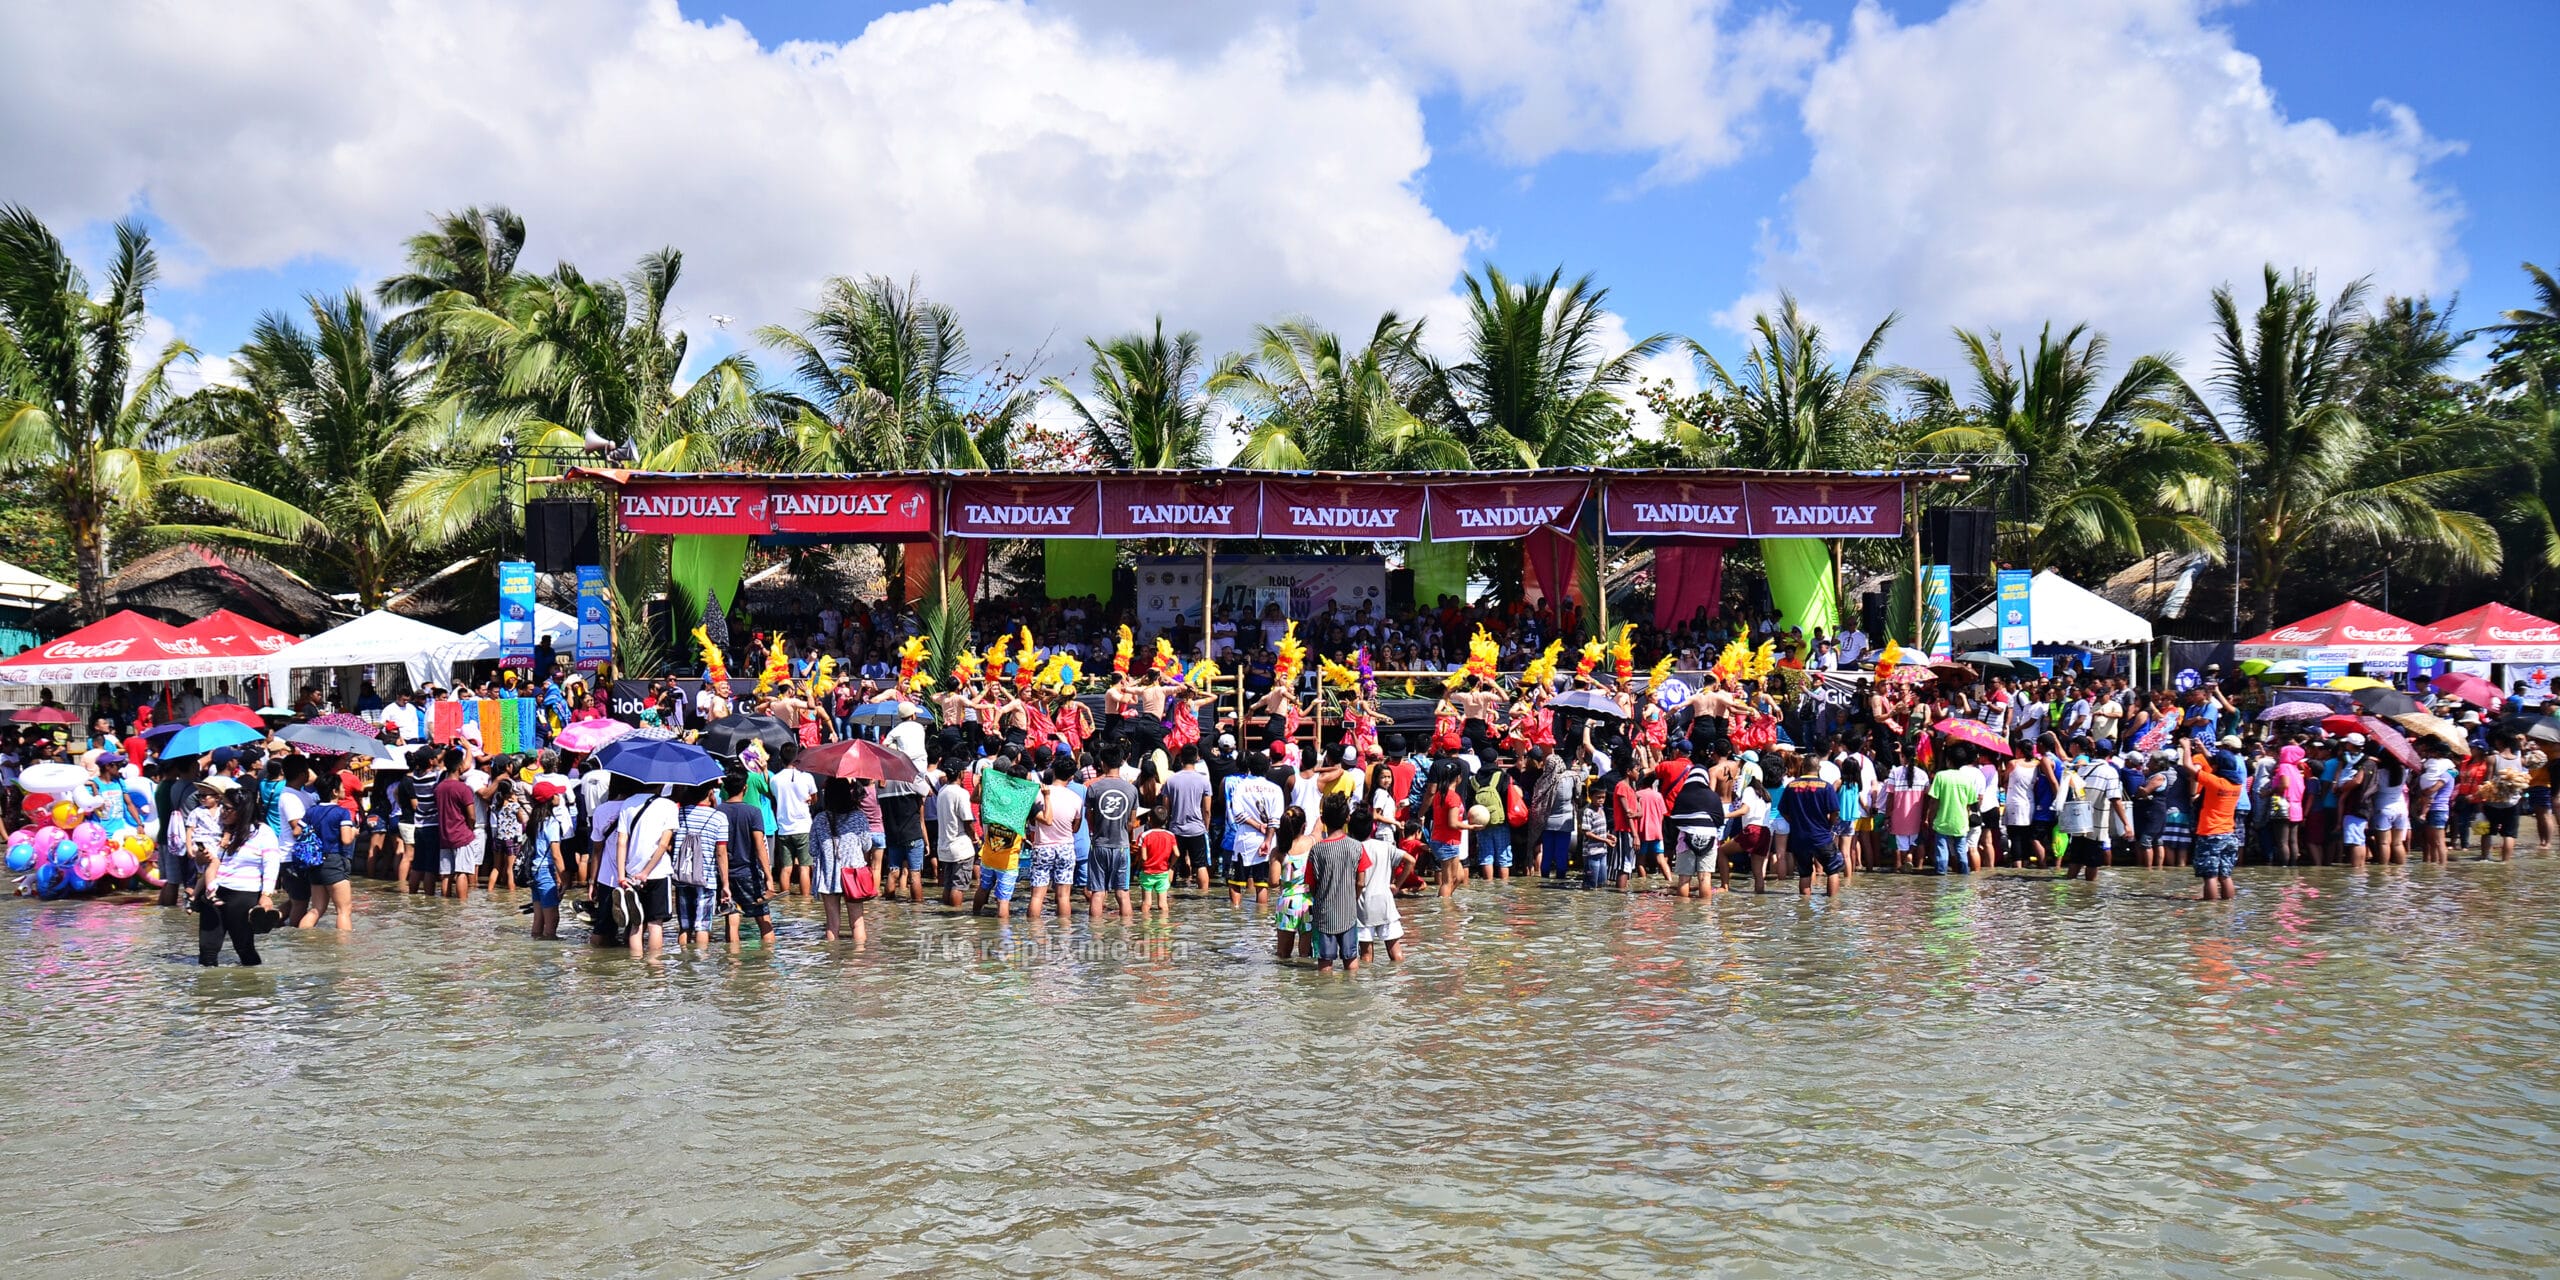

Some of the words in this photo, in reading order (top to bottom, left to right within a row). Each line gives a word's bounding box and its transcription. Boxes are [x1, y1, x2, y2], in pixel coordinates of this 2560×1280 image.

[621, 496, 740, 517] TANDUAY
[771, 494, 892, 516] TANDUAY
[965, 505, 1074, 525] TANDUAY
[1128, 504, 1234, 525] TANDUAY
[1633, 503, 1739, 525] TANDUAY
[1771, 505, 1877, 525] TANDUAY
[1289, 506, 1399, 528] TANDUAY
[1456, 506, 1564, 528] TANDUAY
[2343, 625, 2414, 642] Coca-Cola
[2487, 625, 2560, 641] Coca-Cola
[43, 637, 138, 659] Coca-Cola
[2365, 660, 2408, 668] MEDICUS
[0, 669, 28, 681] oca-Cola
